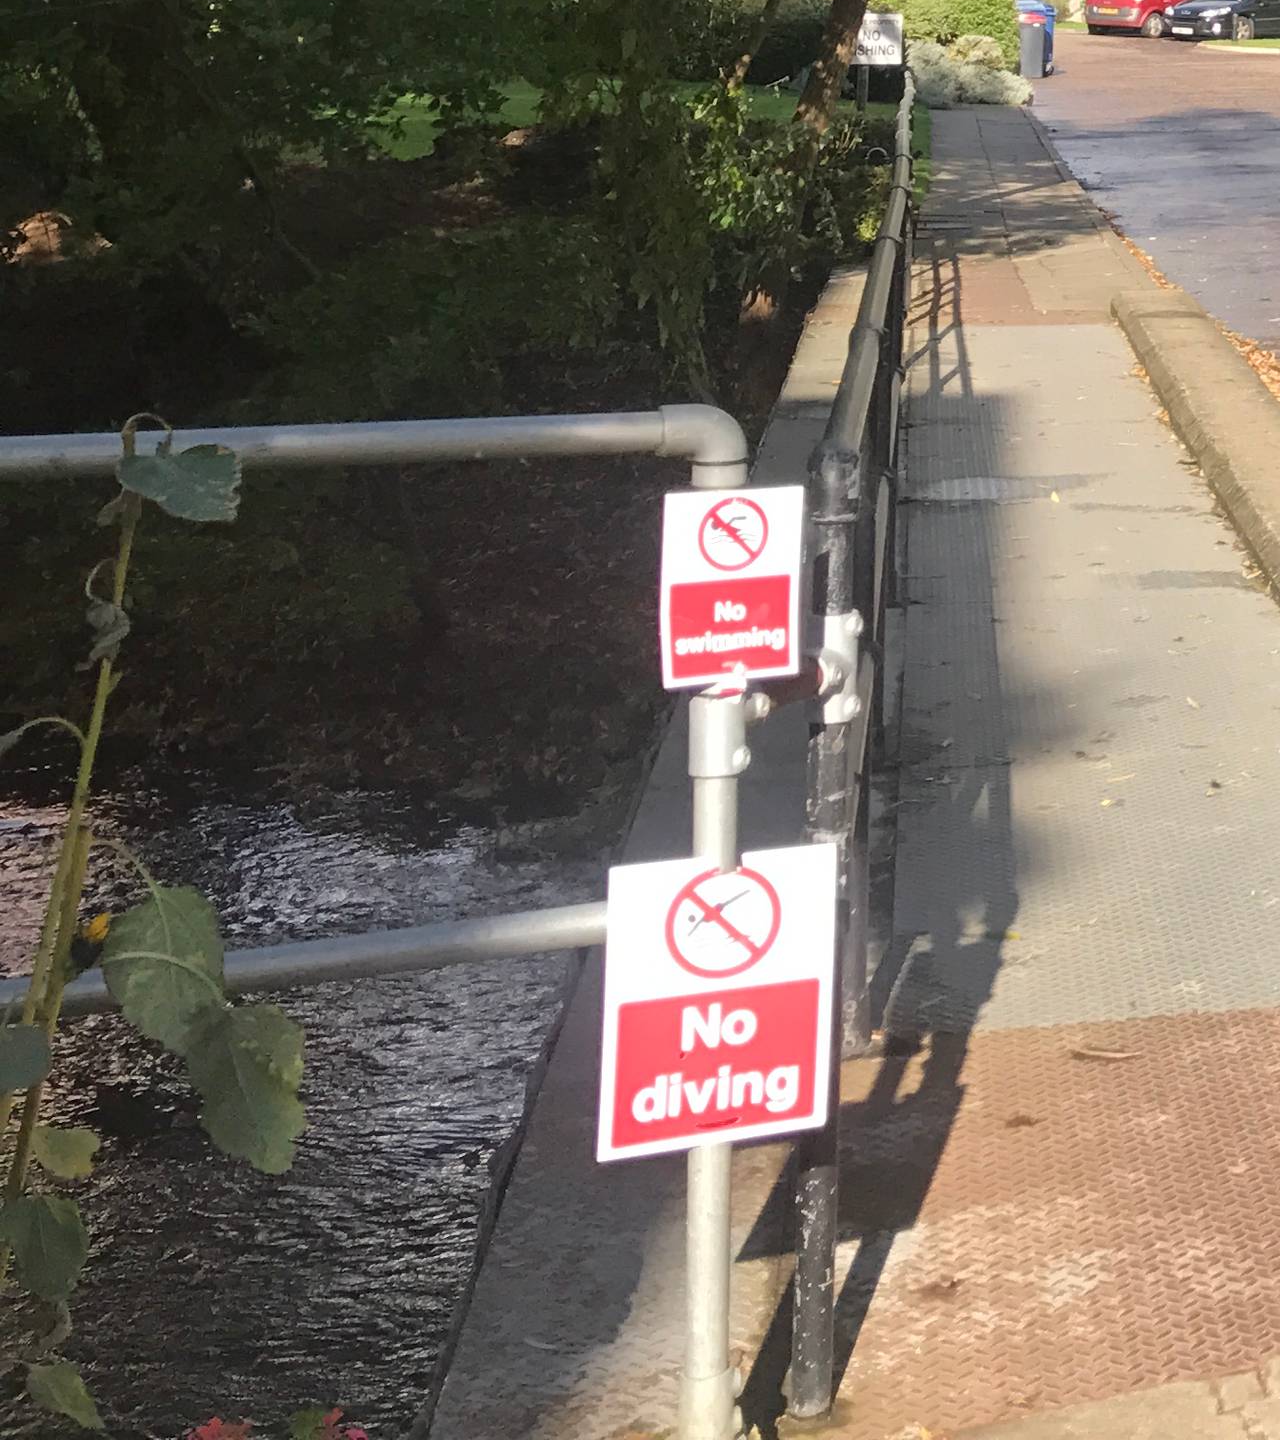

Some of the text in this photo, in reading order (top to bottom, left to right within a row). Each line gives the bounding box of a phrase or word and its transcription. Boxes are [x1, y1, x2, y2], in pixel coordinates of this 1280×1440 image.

[863, 30, 881, 41] NO
[854, 44, 895, 56] ISHING
[714, 600, 747, 623] No
[675, 626, 786, 656] swimming
[681, 1002, 758, 1052] No
[631, 1064, 800, 1124] diving
